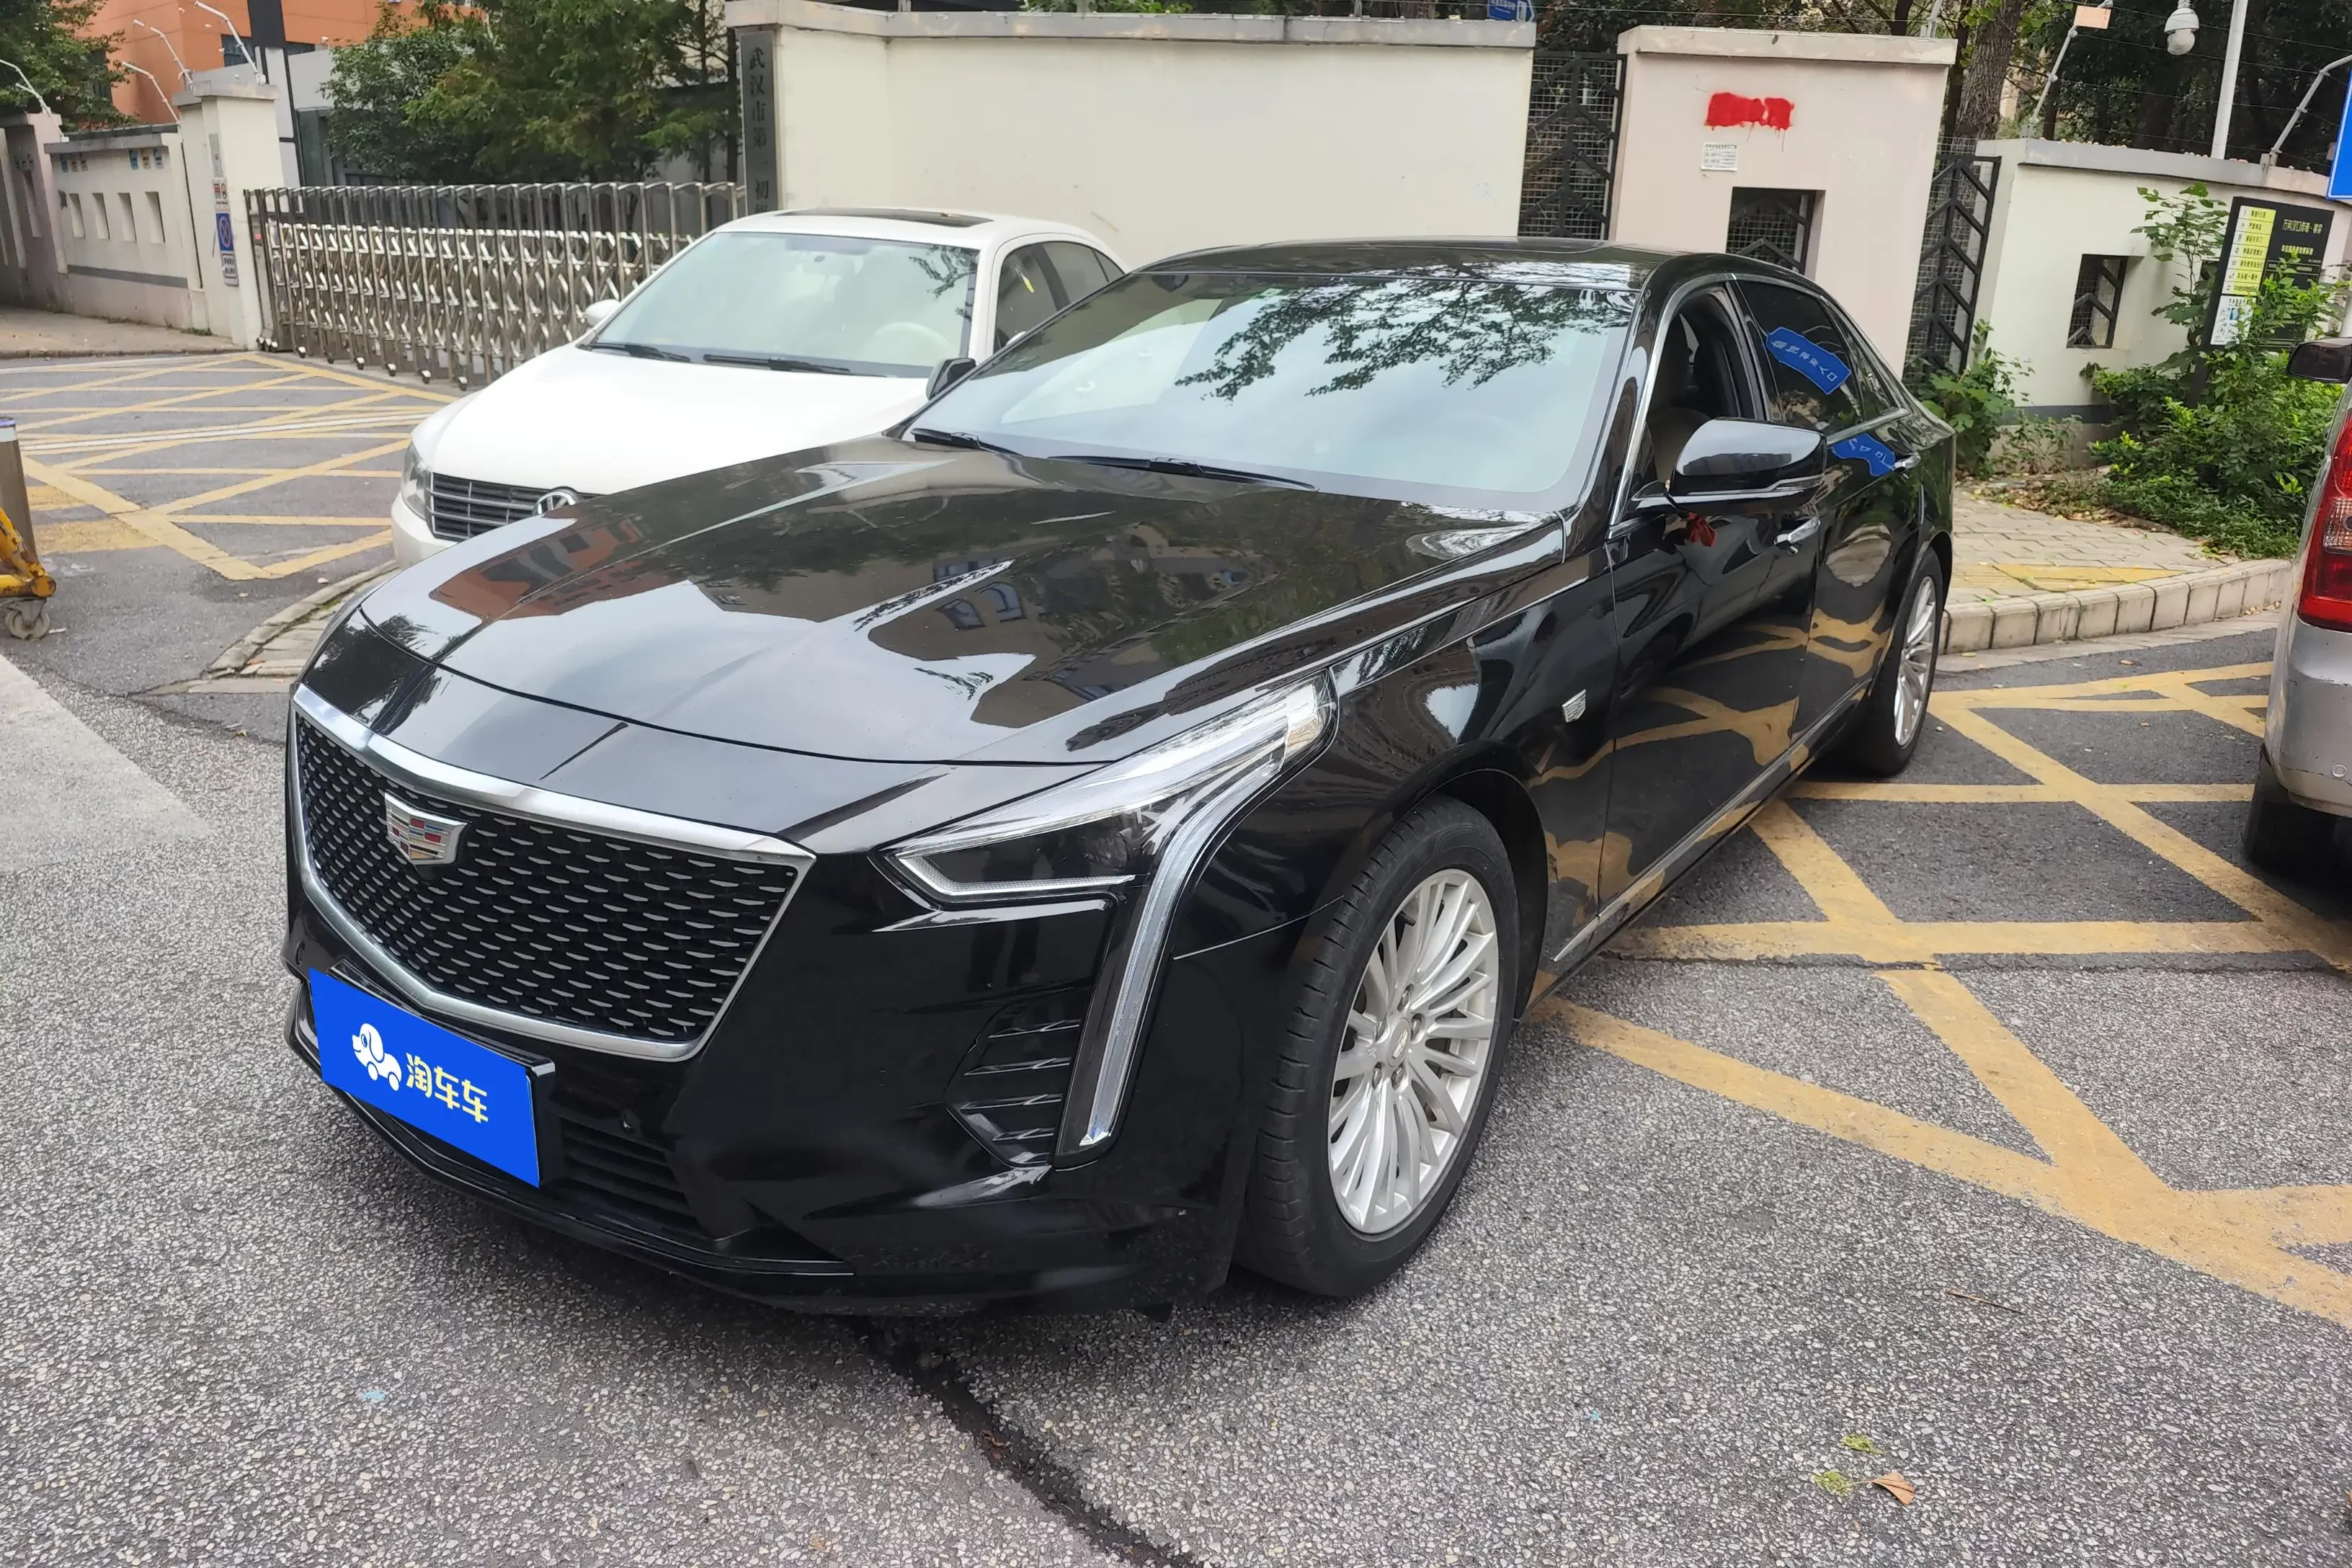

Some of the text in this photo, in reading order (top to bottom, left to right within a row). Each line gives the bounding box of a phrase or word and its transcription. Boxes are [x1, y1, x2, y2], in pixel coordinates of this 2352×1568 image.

[749, 47, 769, 213] 武汉市第初
